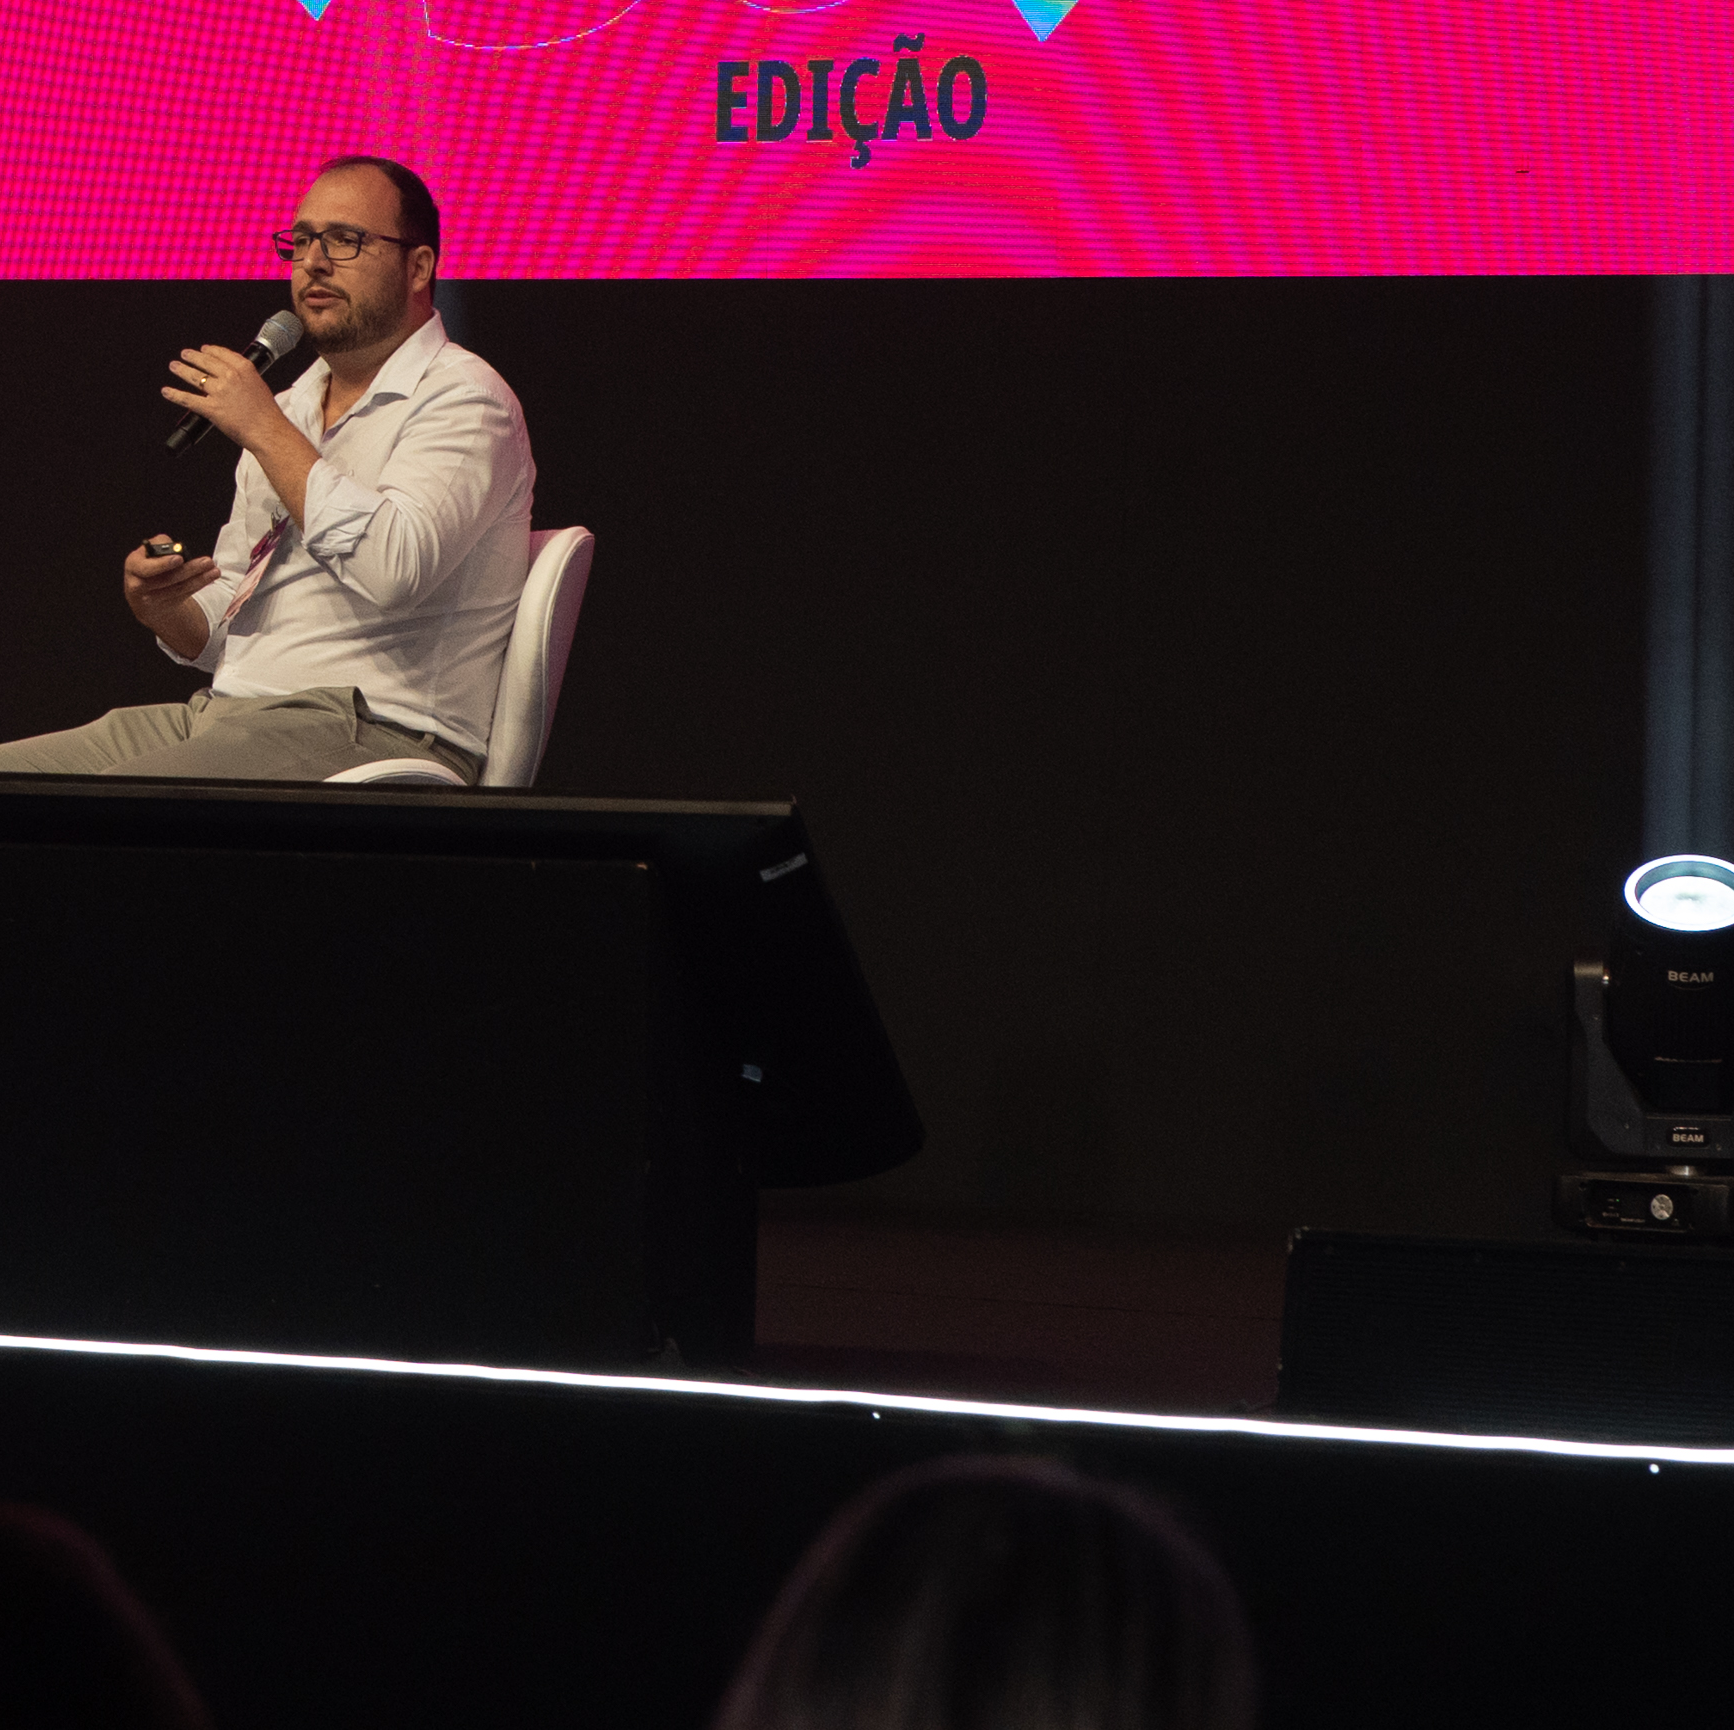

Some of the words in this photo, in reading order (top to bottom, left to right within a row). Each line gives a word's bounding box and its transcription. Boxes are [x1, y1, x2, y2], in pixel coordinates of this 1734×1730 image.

[715, 32, 988, 169] EDIÇÃO
[1667, 970, 1715, 983] BEAM
[1672, 1132, 1705, 1143] BEAM
